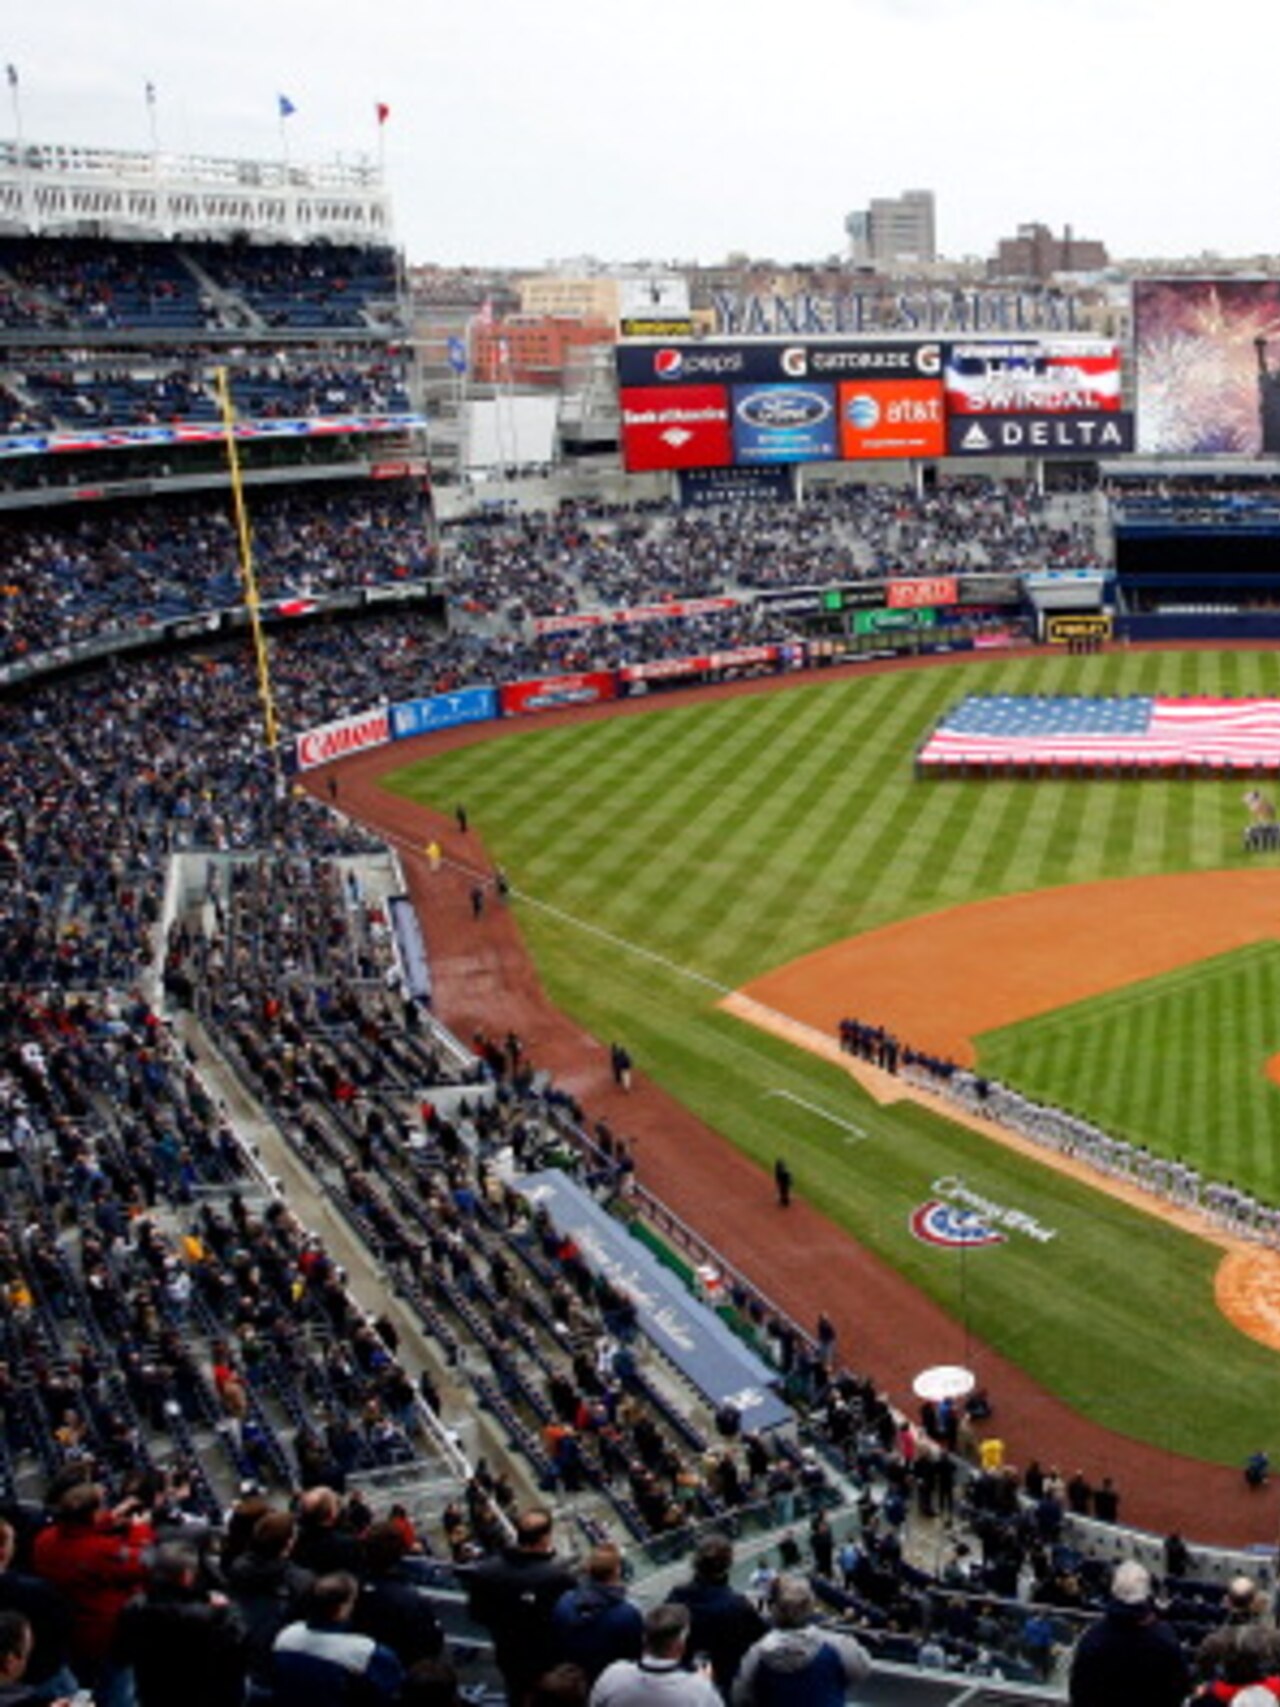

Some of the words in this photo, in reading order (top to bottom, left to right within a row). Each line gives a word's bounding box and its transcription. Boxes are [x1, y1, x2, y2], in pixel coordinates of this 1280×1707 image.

[713, 293, 873, 334] YANKEE
[898, 291, 1078, 332] STADIUM
[682, 353, 743, 374] pepsi
[886, 397, 941, 423] at&t
[1002, 421, 1122, 446] DELTA
[300, 717, 388, 765] Canon
